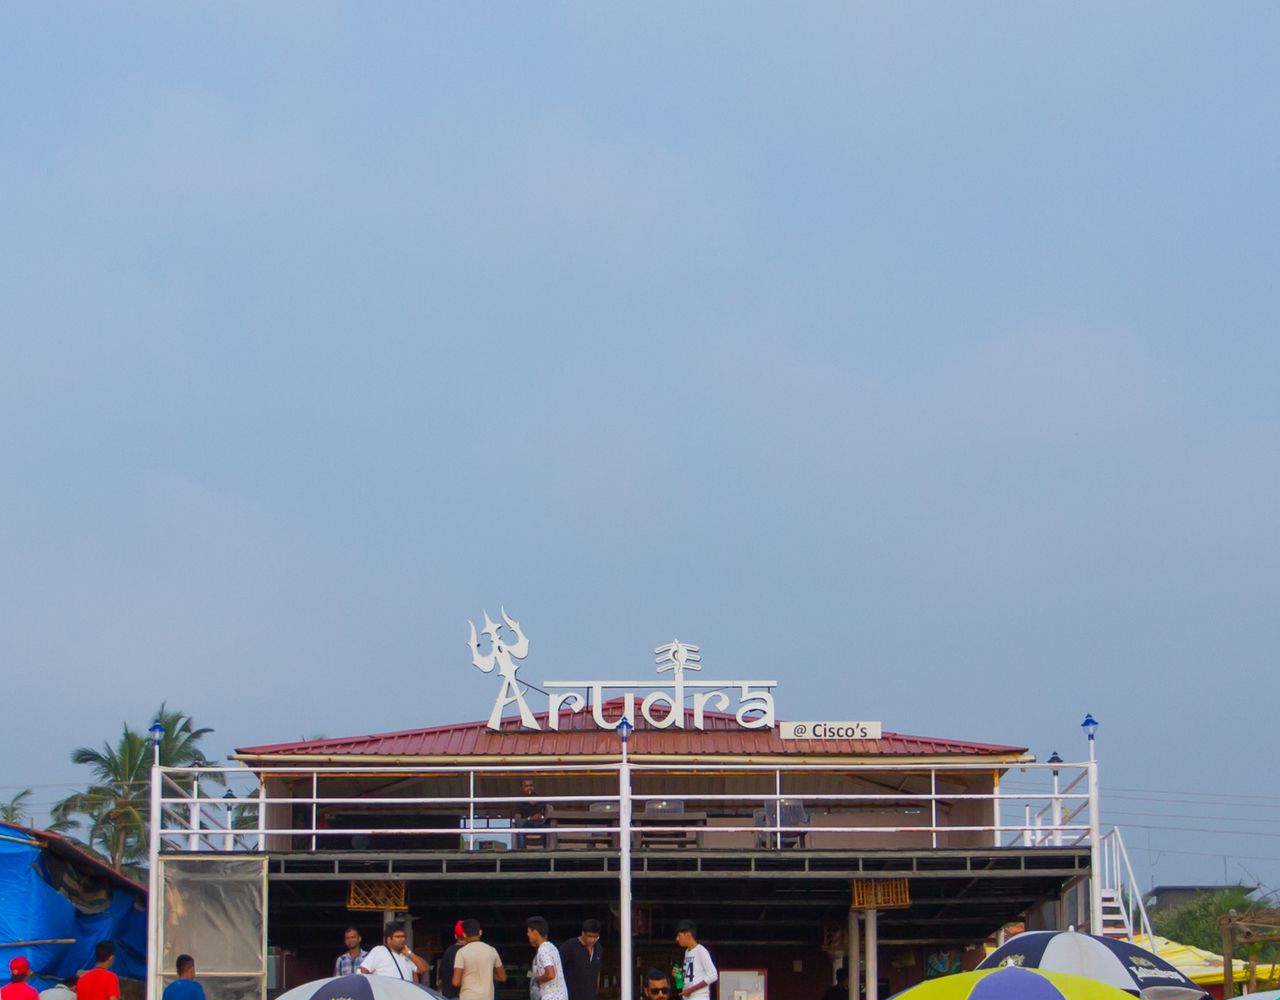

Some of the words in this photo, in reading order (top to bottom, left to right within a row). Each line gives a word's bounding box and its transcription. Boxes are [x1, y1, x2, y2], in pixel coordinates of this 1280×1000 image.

[486, 636, 778, 731] Arudra
[793, 724, 807, 738] @
[812, 723, 868, 738] Cisco's
